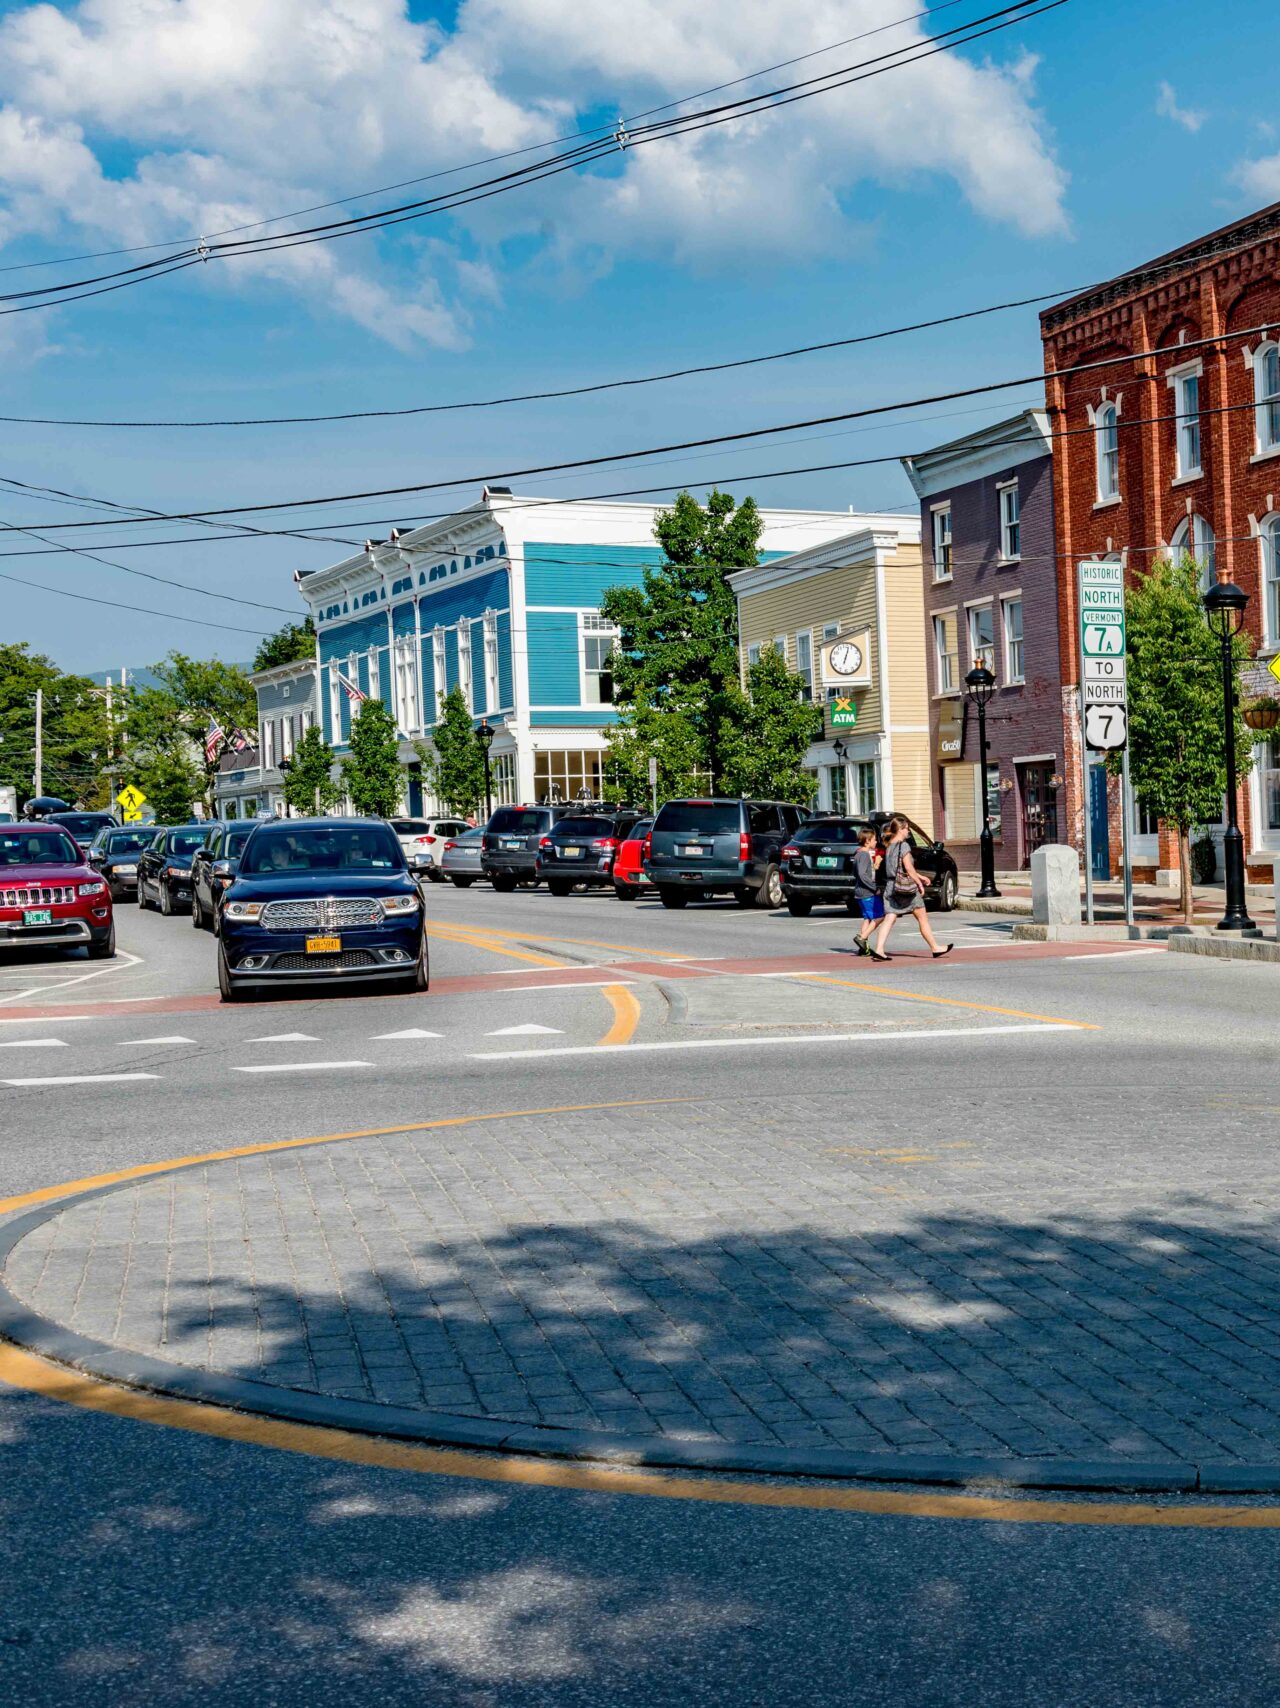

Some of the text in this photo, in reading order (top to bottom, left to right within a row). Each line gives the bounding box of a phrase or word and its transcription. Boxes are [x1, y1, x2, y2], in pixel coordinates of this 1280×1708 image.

[1084, 567, 1119, 580] HISTORIC
[1084, 590, 1120, 604] NORTH
[1085, 612, 1120, 623] VERMONT
[1095, 661, 1114, 675] TO
[1087, 685, 1123, 698] NORTH
[833, 713, 856, 723] ATM
[1098, 715, 1113, 740] 7
